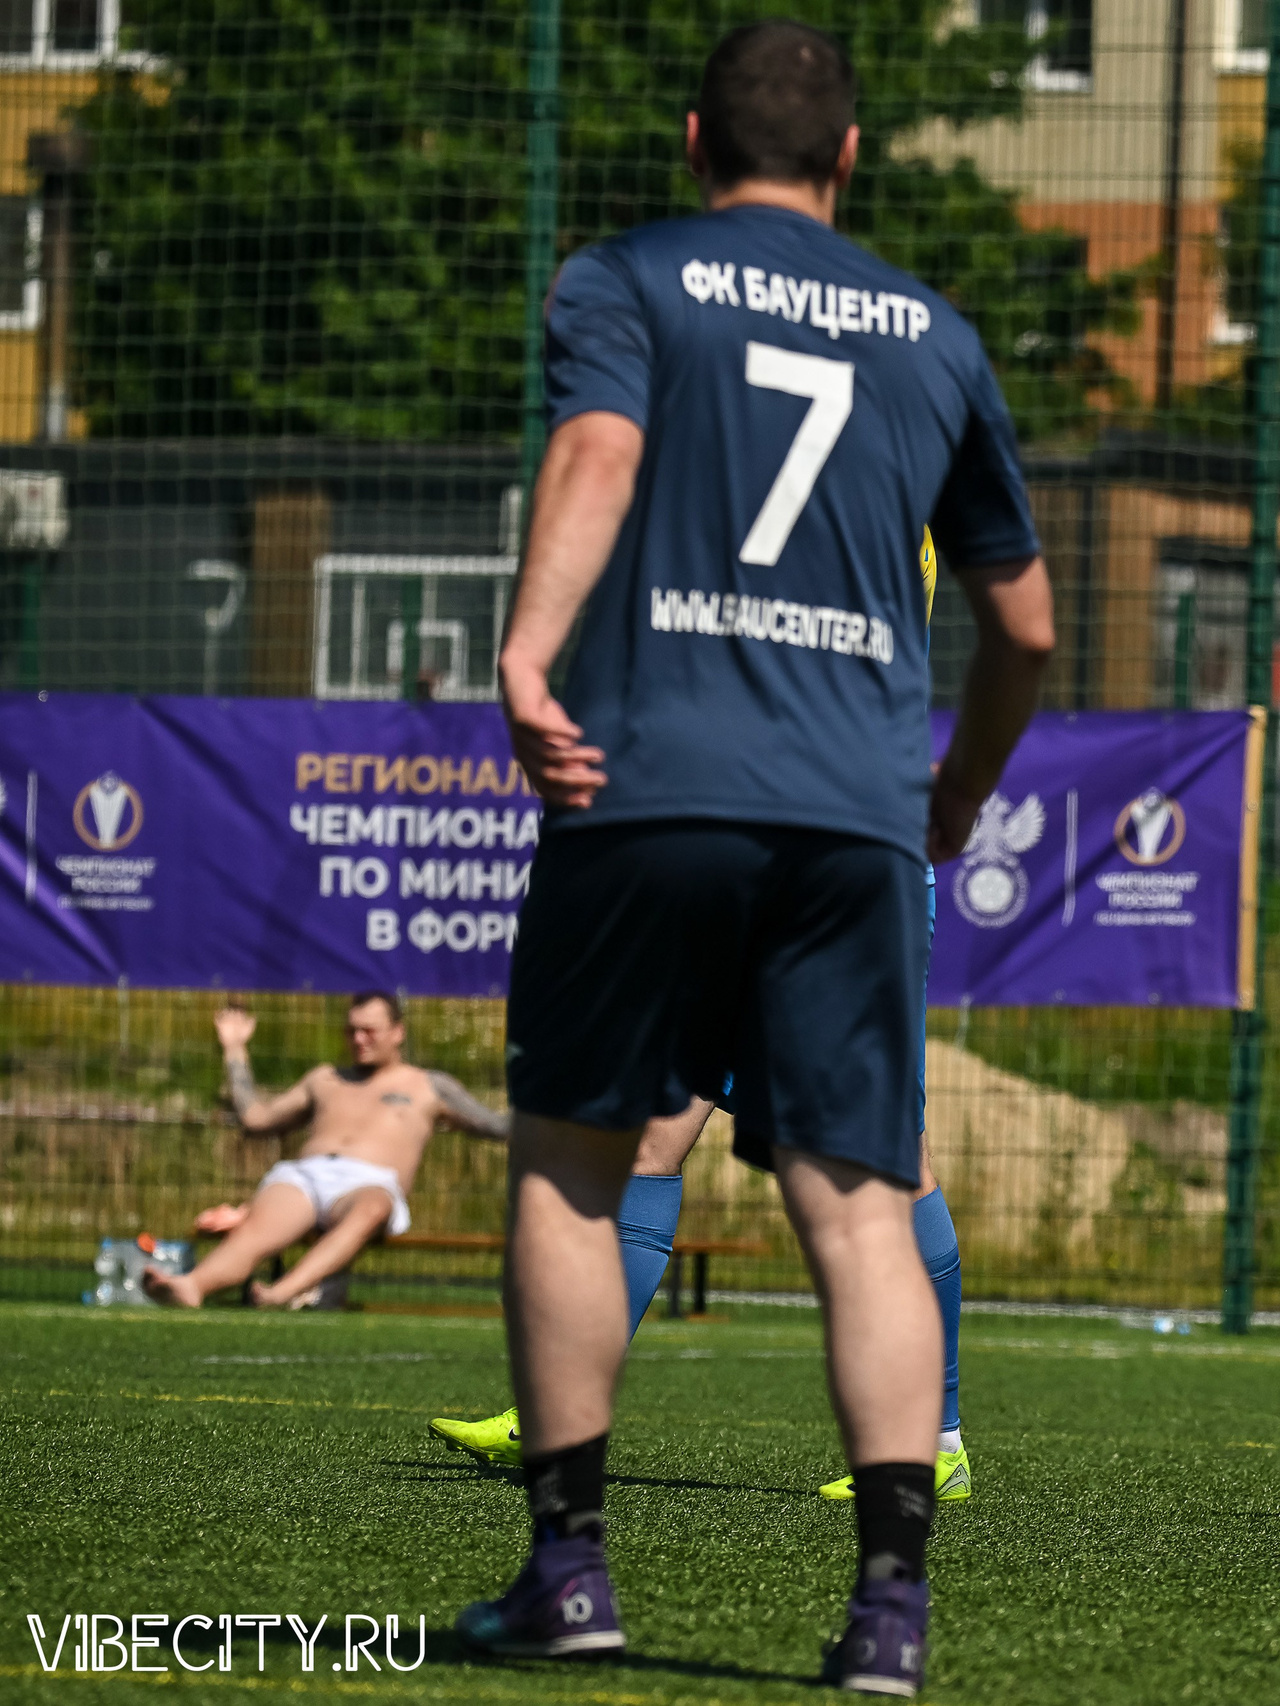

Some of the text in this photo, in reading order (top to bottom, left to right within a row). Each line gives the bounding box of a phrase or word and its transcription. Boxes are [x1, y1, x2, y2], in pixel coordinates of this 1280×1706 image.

[681, 258, 931, 343] ФК БАУЦЕНТР
[739, 340, 855, 567] 7
[295, 752, 541, 798] РЕГИОНАЛ
[290, 804, 544, 850] ЧЕМПИОНА
[319, 855, 389, 899] ПО
[366, 909, 400, 950] В
